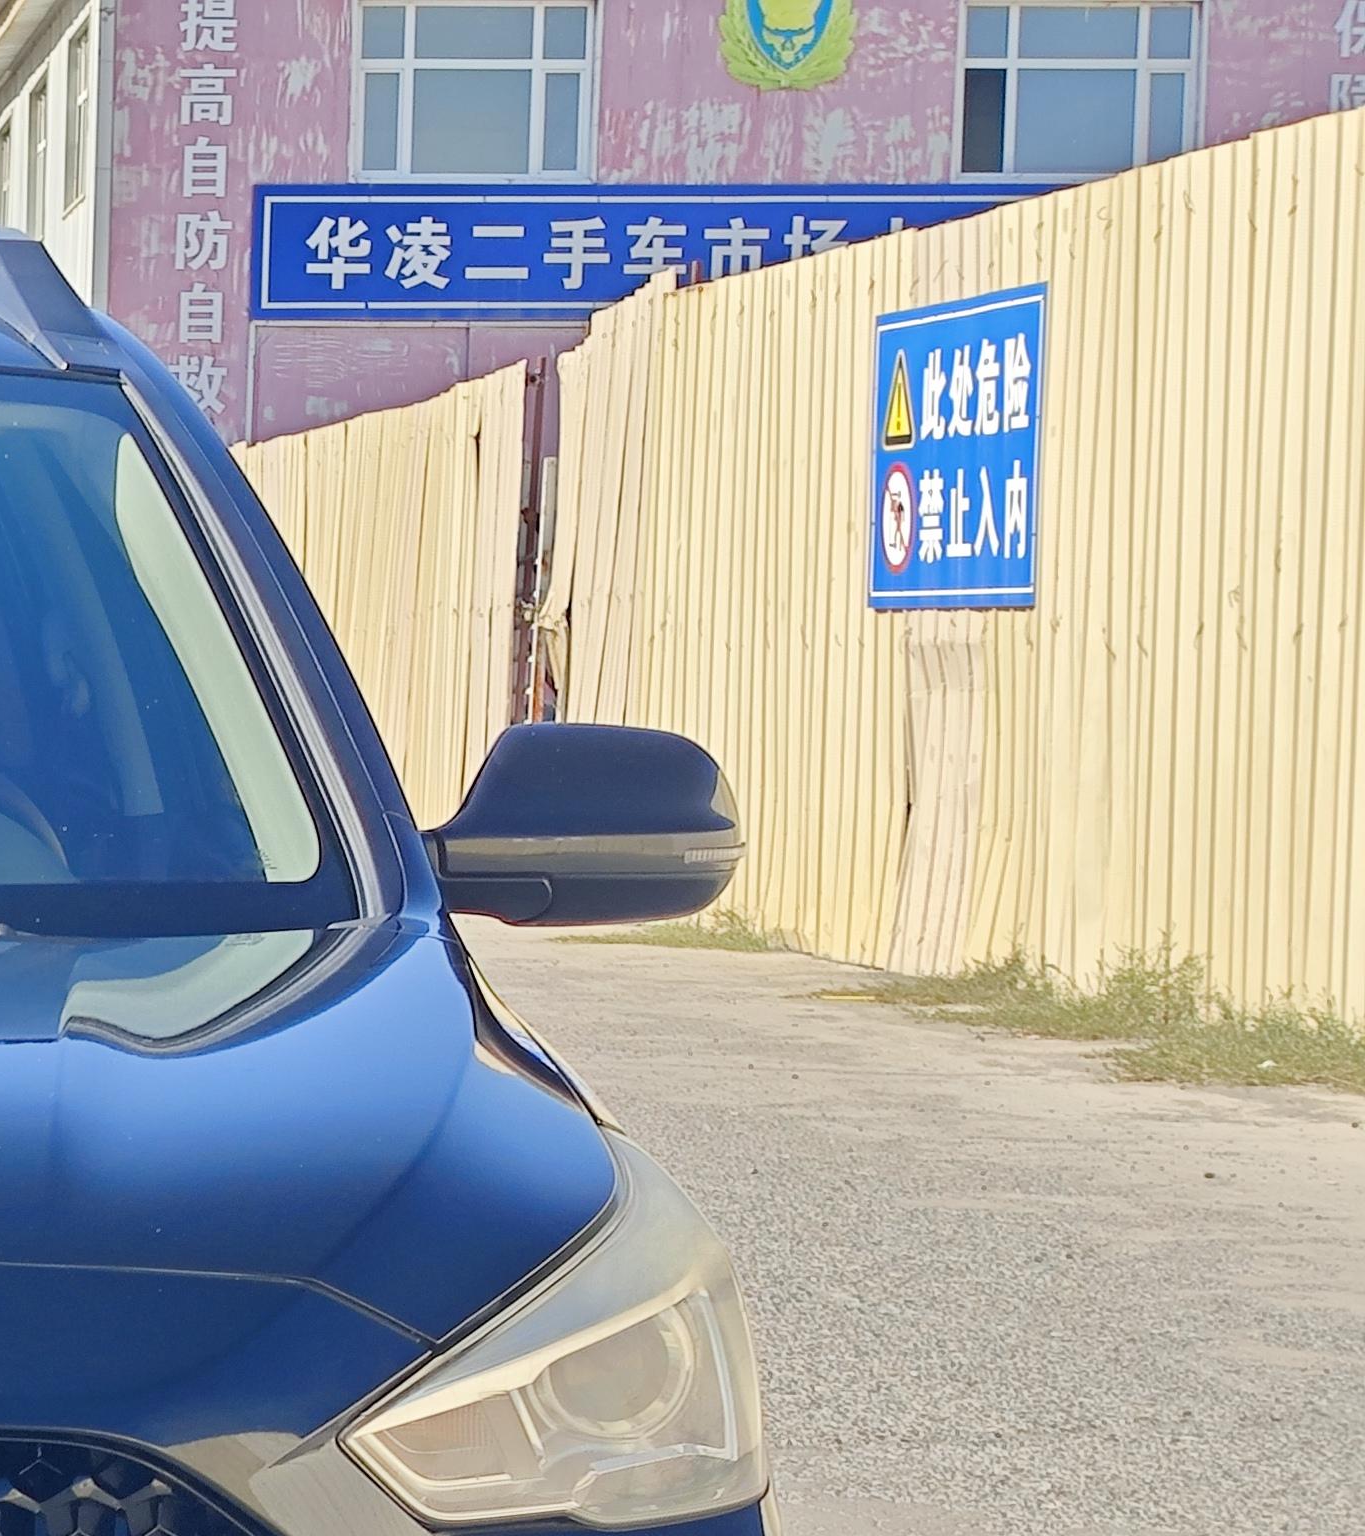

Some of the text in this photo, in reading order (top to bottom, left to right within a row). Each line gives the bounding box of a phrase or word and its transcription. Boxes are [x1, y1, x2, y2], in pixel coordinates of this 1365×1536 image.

[305, 214, 904, 291] 华凌二手车市场
[920, 332, 1032, 441] 此处危险
[918, 459, 1028, 564] 禁止入内
